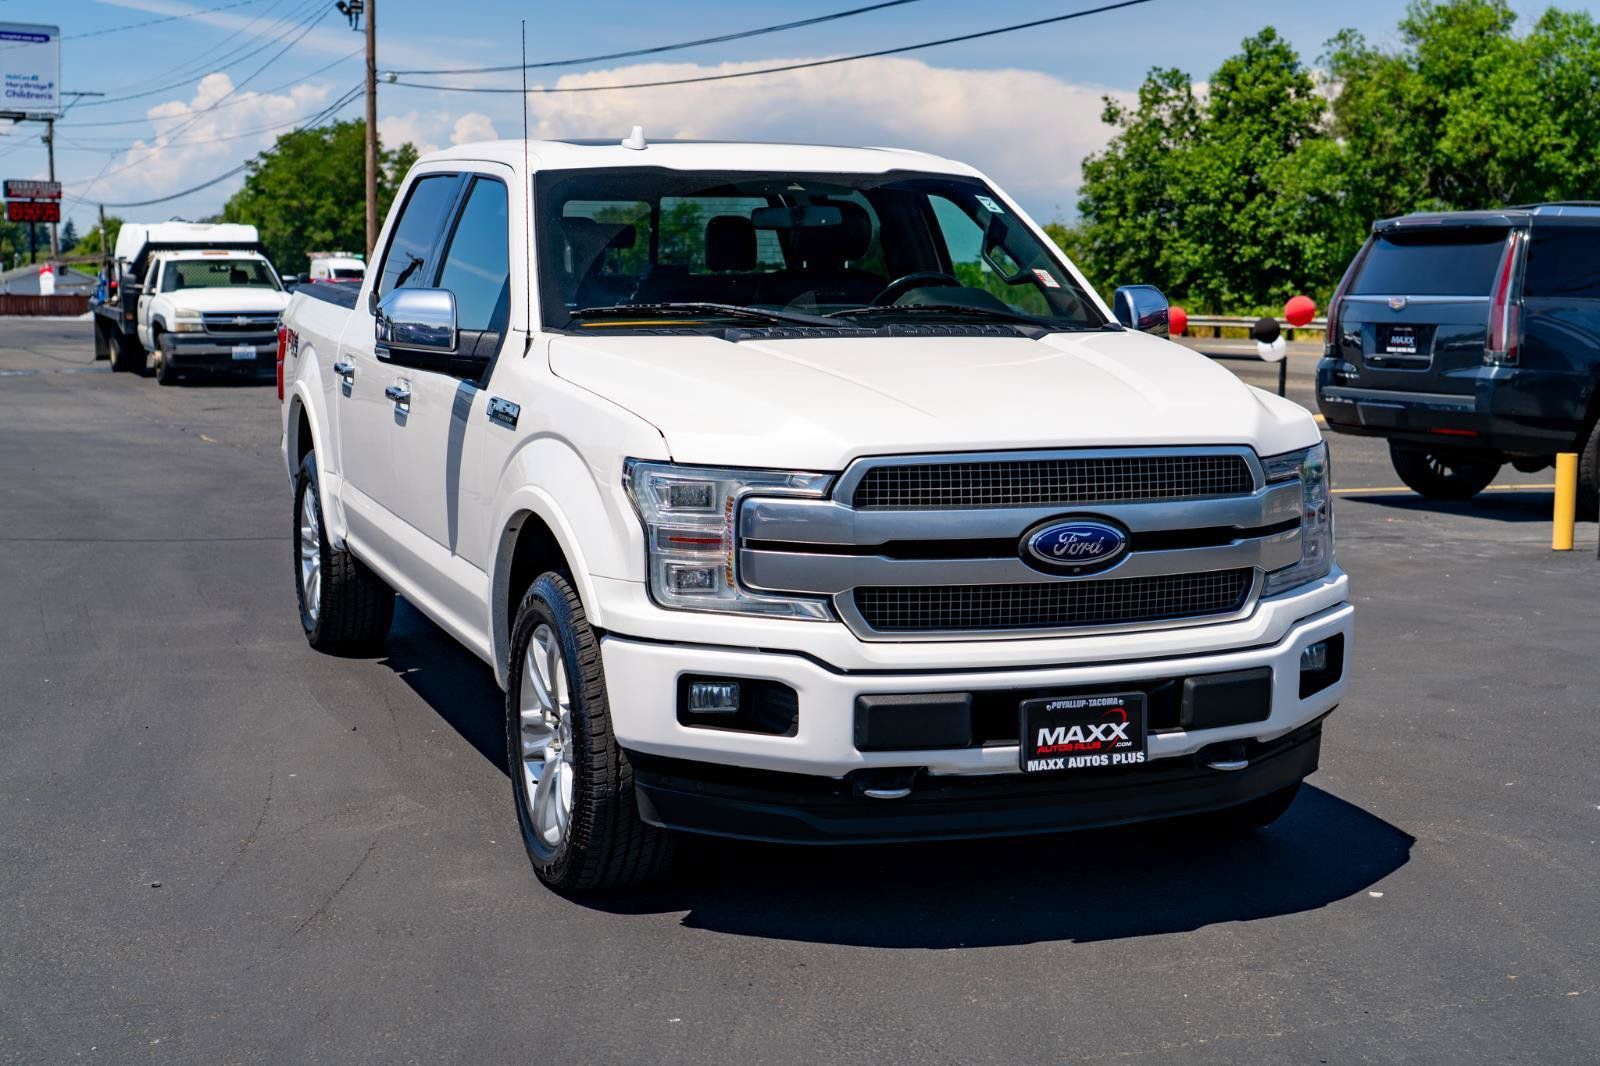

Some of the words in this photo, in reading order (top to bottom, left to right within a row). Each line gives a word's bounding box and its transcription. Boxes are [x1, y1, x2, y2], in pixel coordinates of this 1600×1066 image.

[1391, 336, 1415, 344] MAXX
[1053, 531, 1105, 556] Ford
[1037, 721, 1130, 747] MAXX
[1036, 743, 1073, 754] AUTOS
[1074, 741, 1102, 750] PLUS
[1027, 758, 1065, 772] MAXX
[1068, 755, 1109, 769] AUTOS
[1112, 751, 1145, 765] PLUS
